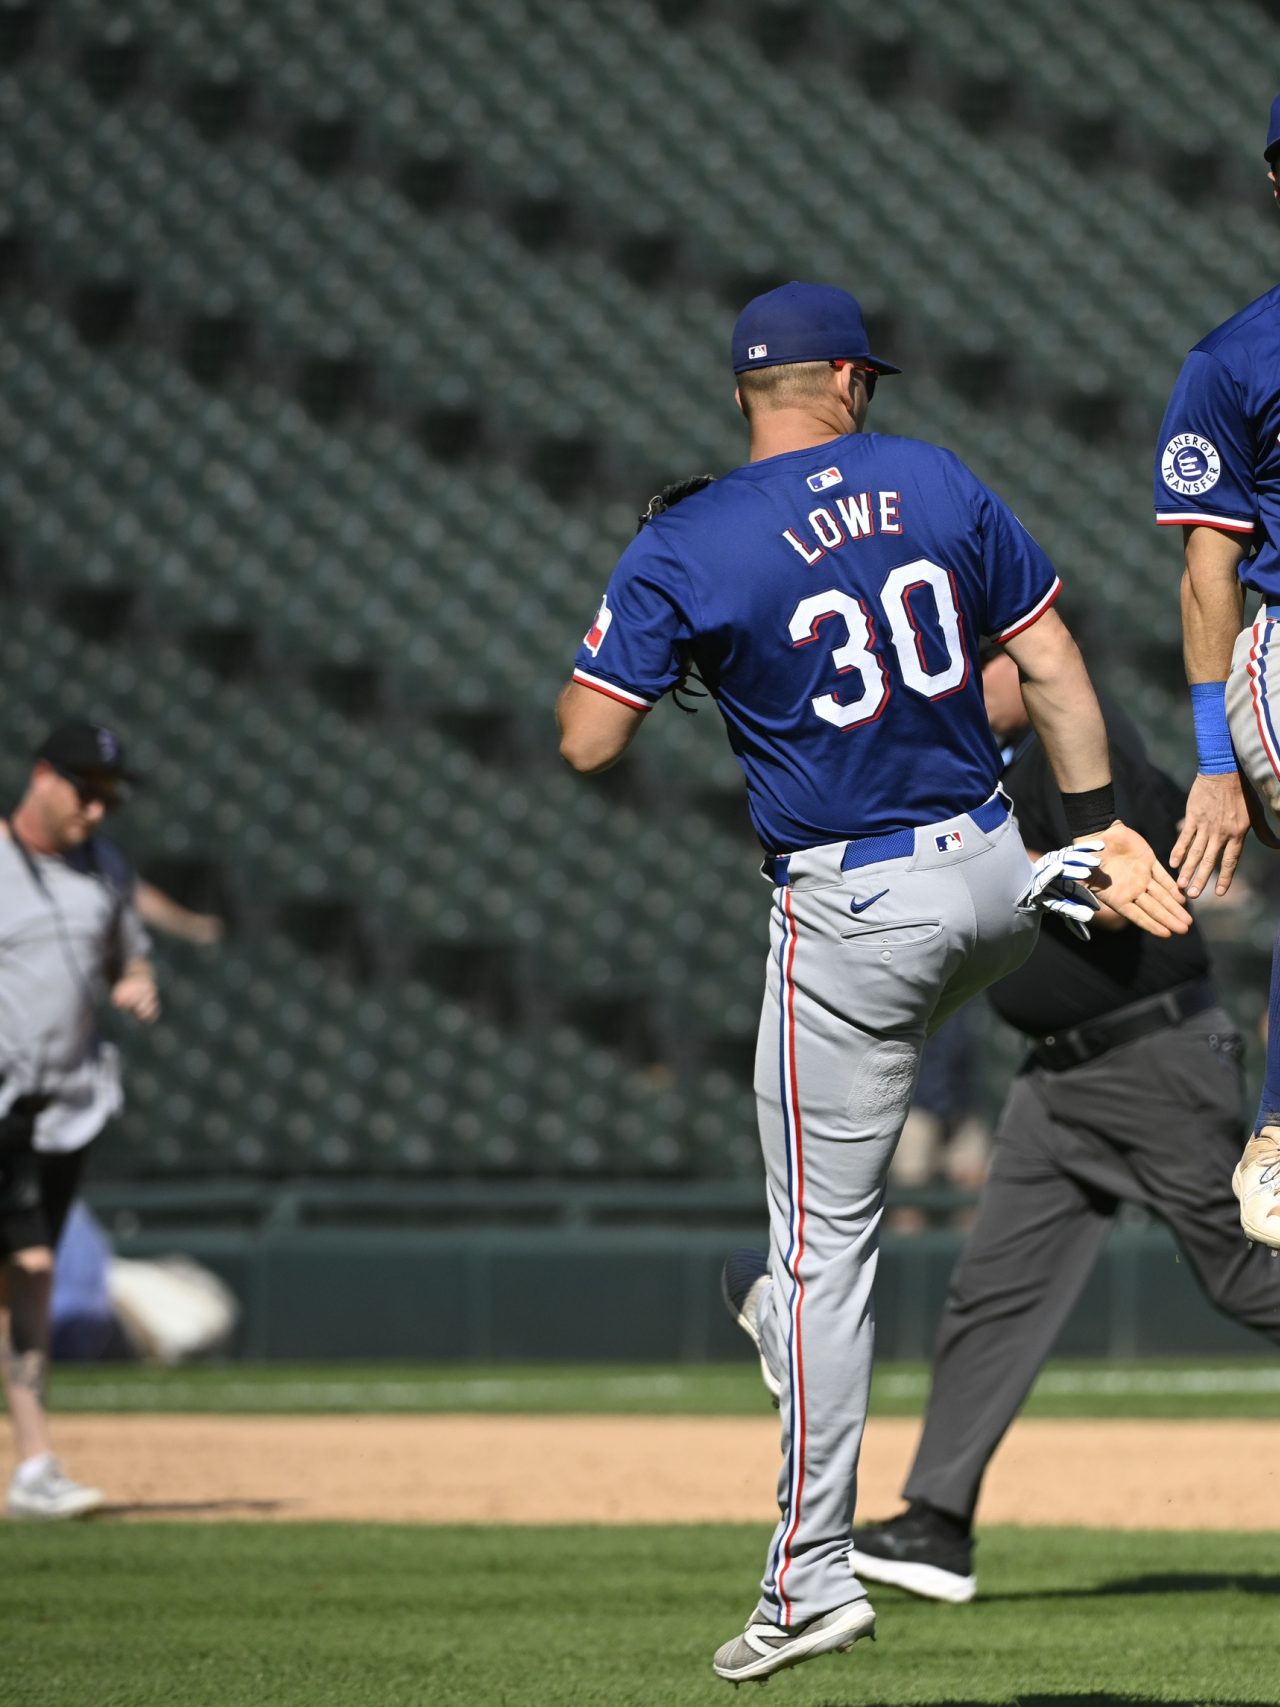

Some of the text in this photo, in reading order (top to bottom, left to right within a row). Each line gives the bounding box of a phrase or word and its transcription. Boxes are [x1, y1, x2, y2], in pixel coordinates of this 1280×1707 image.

[1167, 435, 1217, 455] ENERGY
[1163, 465, 1219, 494] TRANSFER
[782, 491, 903, 566] LOWE
[787, 556, 969, 732] 30
